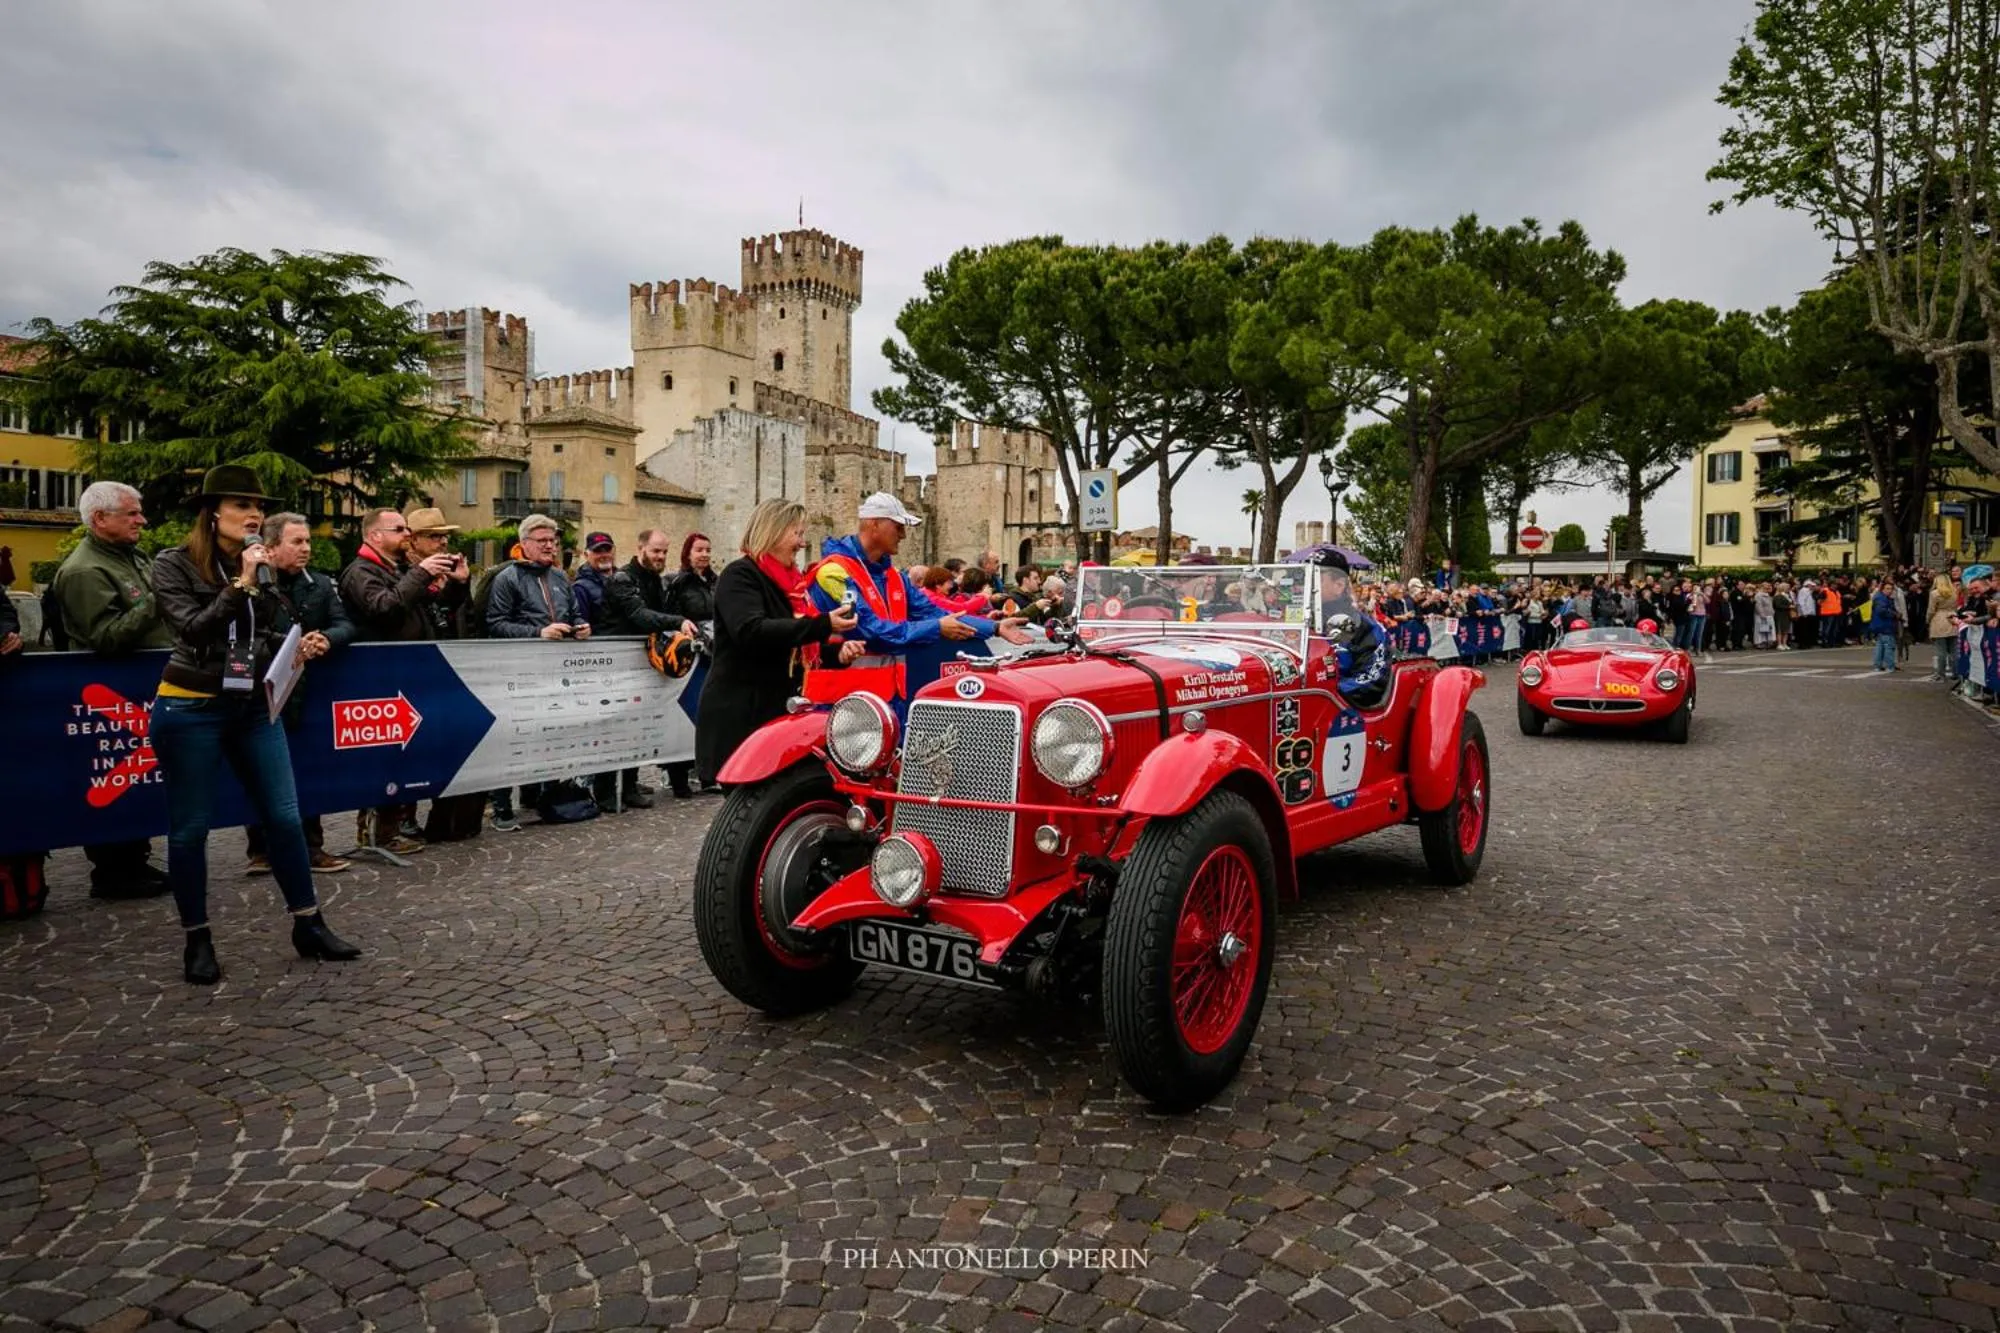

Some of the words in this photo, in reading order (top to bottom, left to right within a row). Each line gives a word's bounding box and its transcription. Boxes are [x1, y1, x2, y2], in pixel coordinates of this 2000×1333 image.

[563, 657, 613, 668] CHOPARD
[944, 664, 967, 677] 1000
[960, 681, 979, 693] OM
[1183, 672, 1208, 687] Kirill
[1176, 686, 1208, 703] Mikhail
[1605, 682, 1640, 697] 1000
[73, 701, 133, 717] THE
[343, 703, 398, 722] 1000
[67, 718, 152, 736] BEAUTI
[341, 723, 403, 744] MIGLIA
[99, 736, 152, 752] RACE
[93, 757, 115, 771] IN
[1342, 742, 1352, 772] 3
[858, 925, 900, 963] GN
